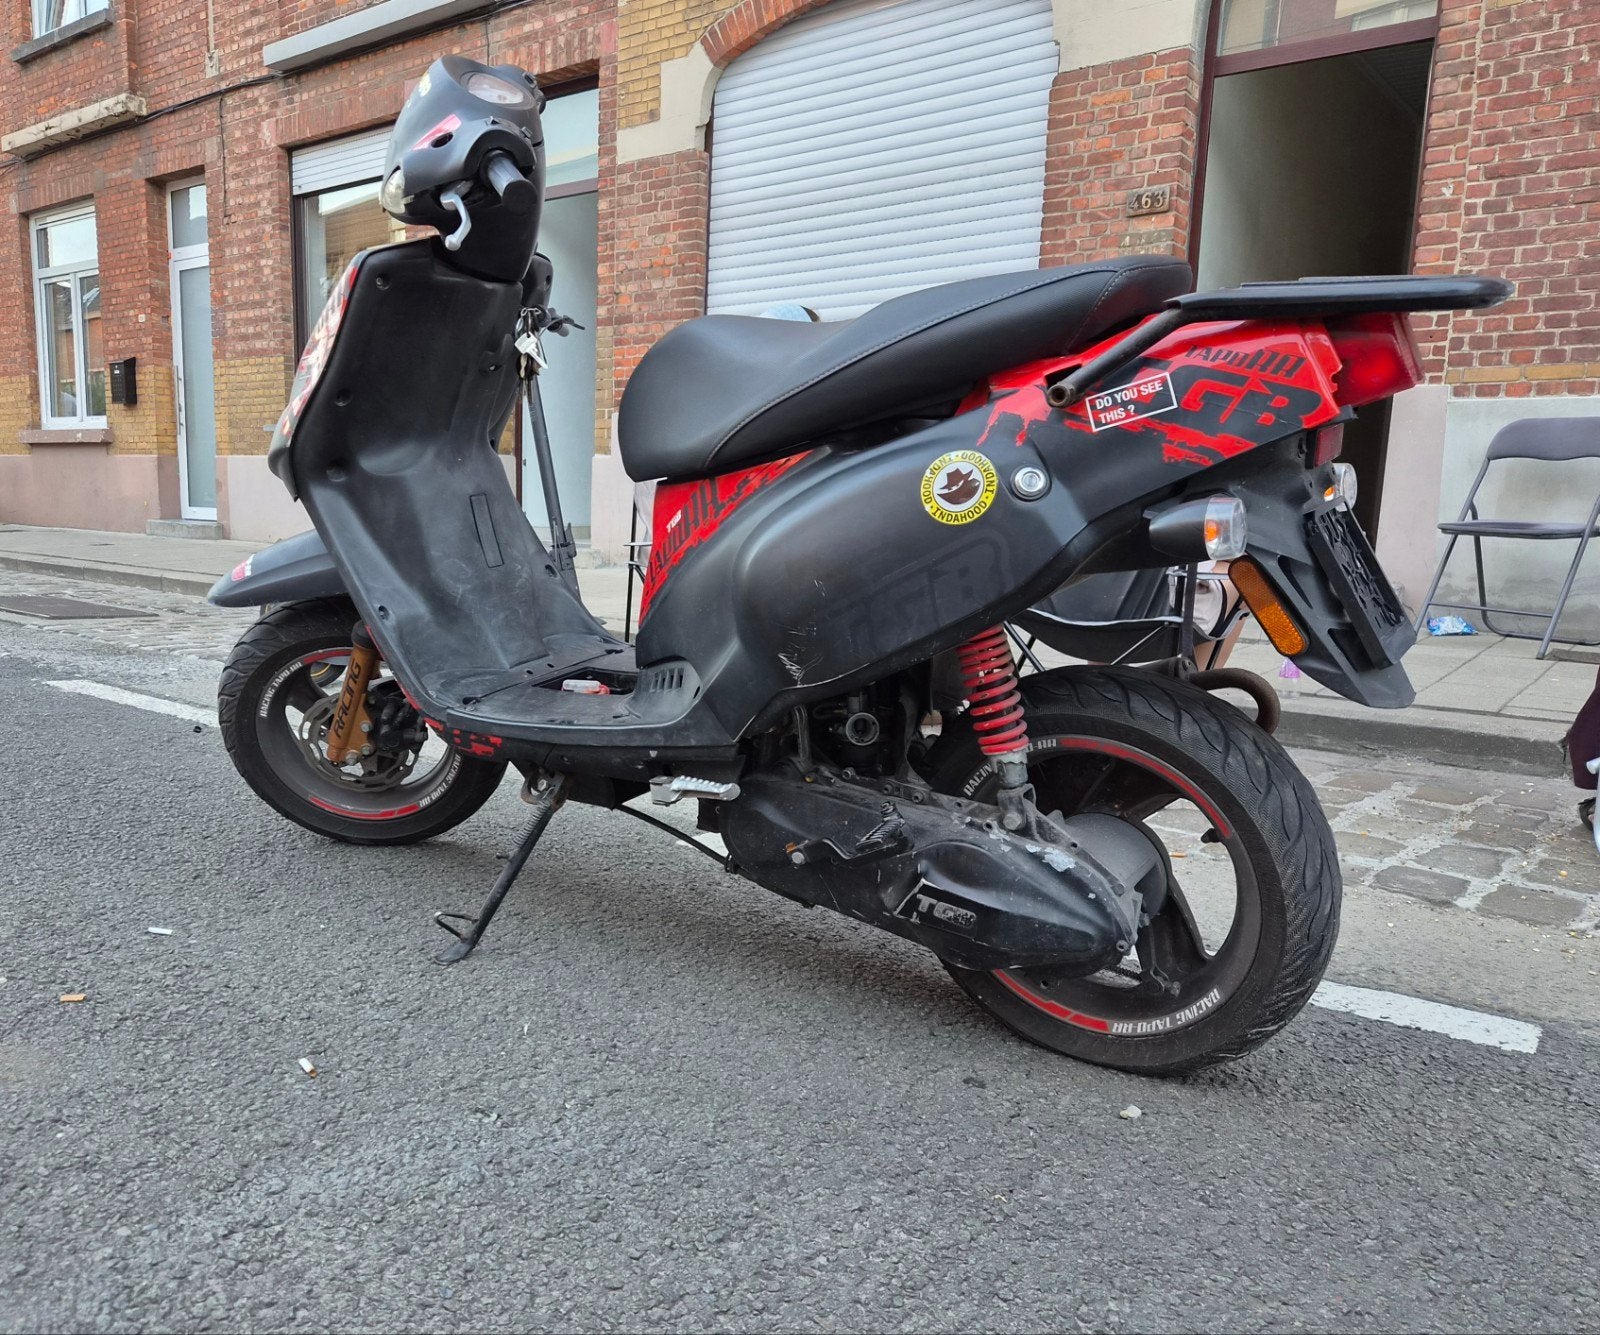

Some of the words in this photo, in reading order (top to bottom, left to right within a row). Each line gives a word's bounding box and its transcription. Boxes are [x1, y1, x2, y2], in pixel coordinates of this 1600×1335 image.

[1129, 190, 1166, 212] 463
[1095, 396, 1113, 410] DO
[1113, 387, 1139, 403] YOU
[1140, 380, 1164, 396] SEE
[1098, 407, 1126, 424] THIS
[1127, 404, 1136, 415] ?
[961, 451, 996, 495] INDAHOOD
[931, 501, 988, 523] INDAHOOD
[258, 688, 276, 718] RACING
[333, 658, 362, 739] RACING
[445, 753, 462, 784] RACING
[963, 763, 993, 797] RACIN
[1176, 987, 1222, 1026] RACING
